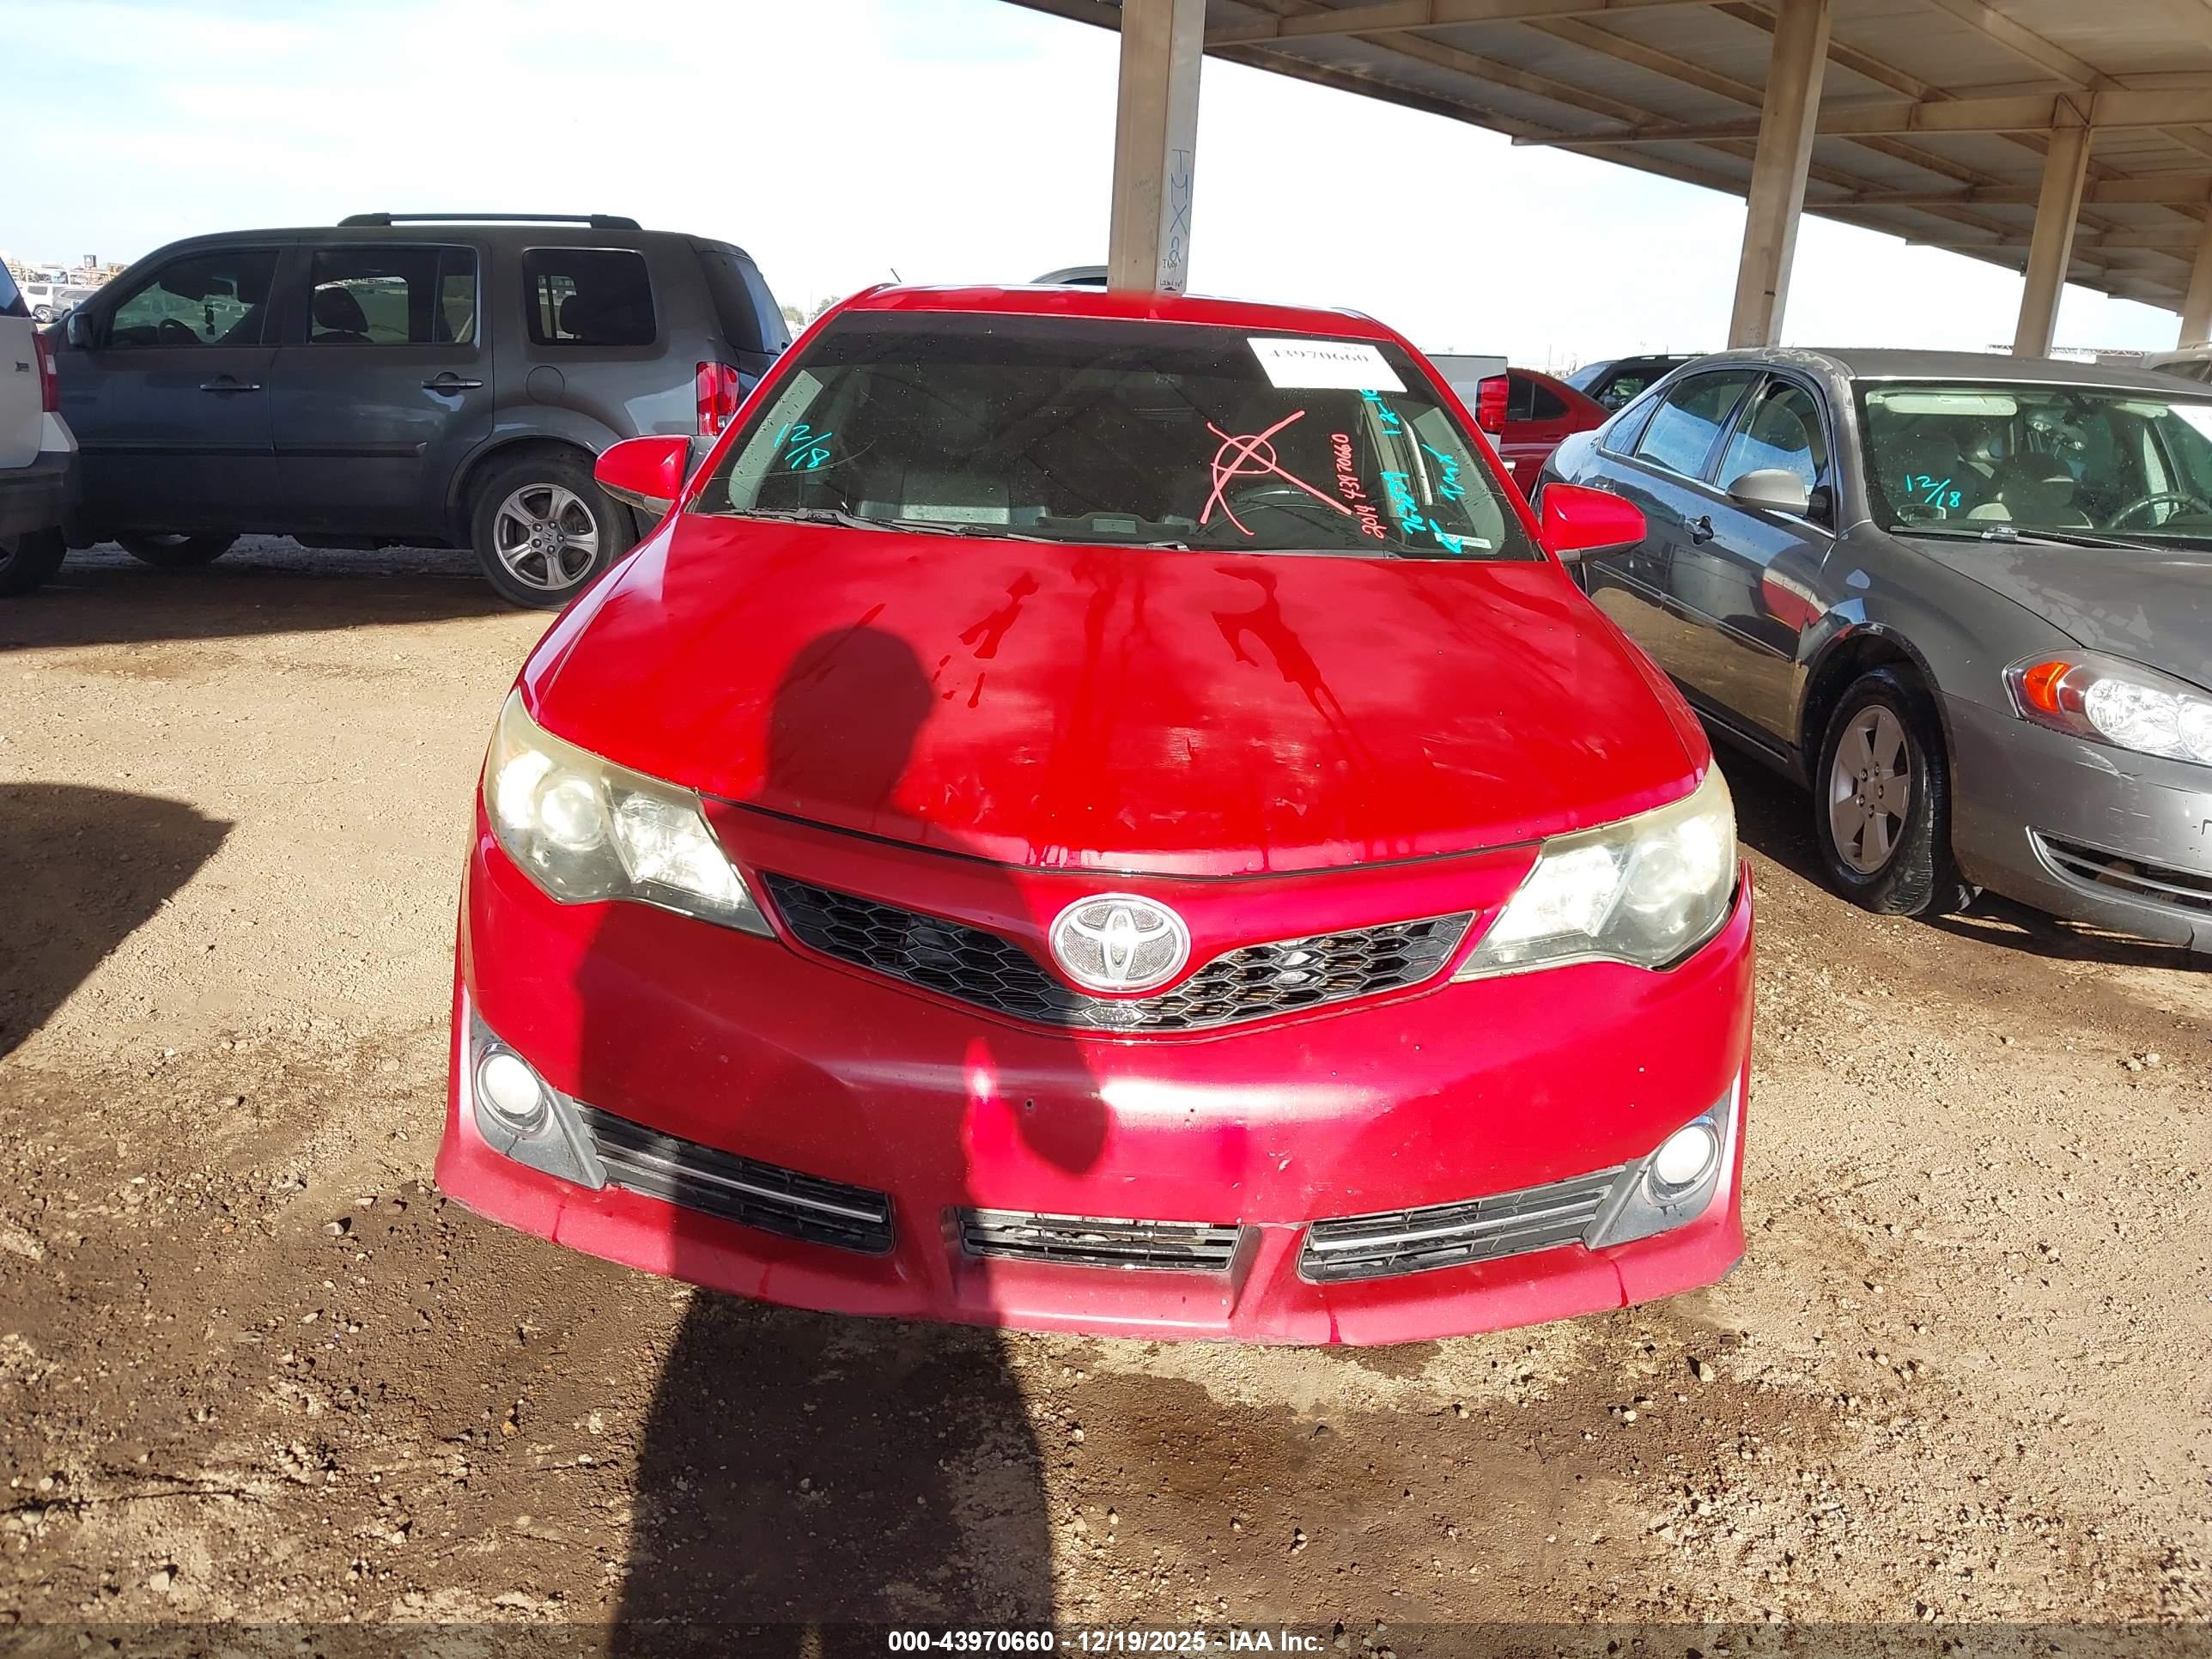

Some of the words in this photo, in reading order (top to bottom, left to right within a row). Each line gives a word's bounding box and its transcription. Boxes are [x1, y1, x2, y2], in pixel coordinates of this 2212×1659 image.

[773, 422, 833, 471] 12/18
[1330, 433, 1367, 500] 43970660
[1905, 474, 1962, 508] 12/18
[1353, 504, 1388, 539] 2014
